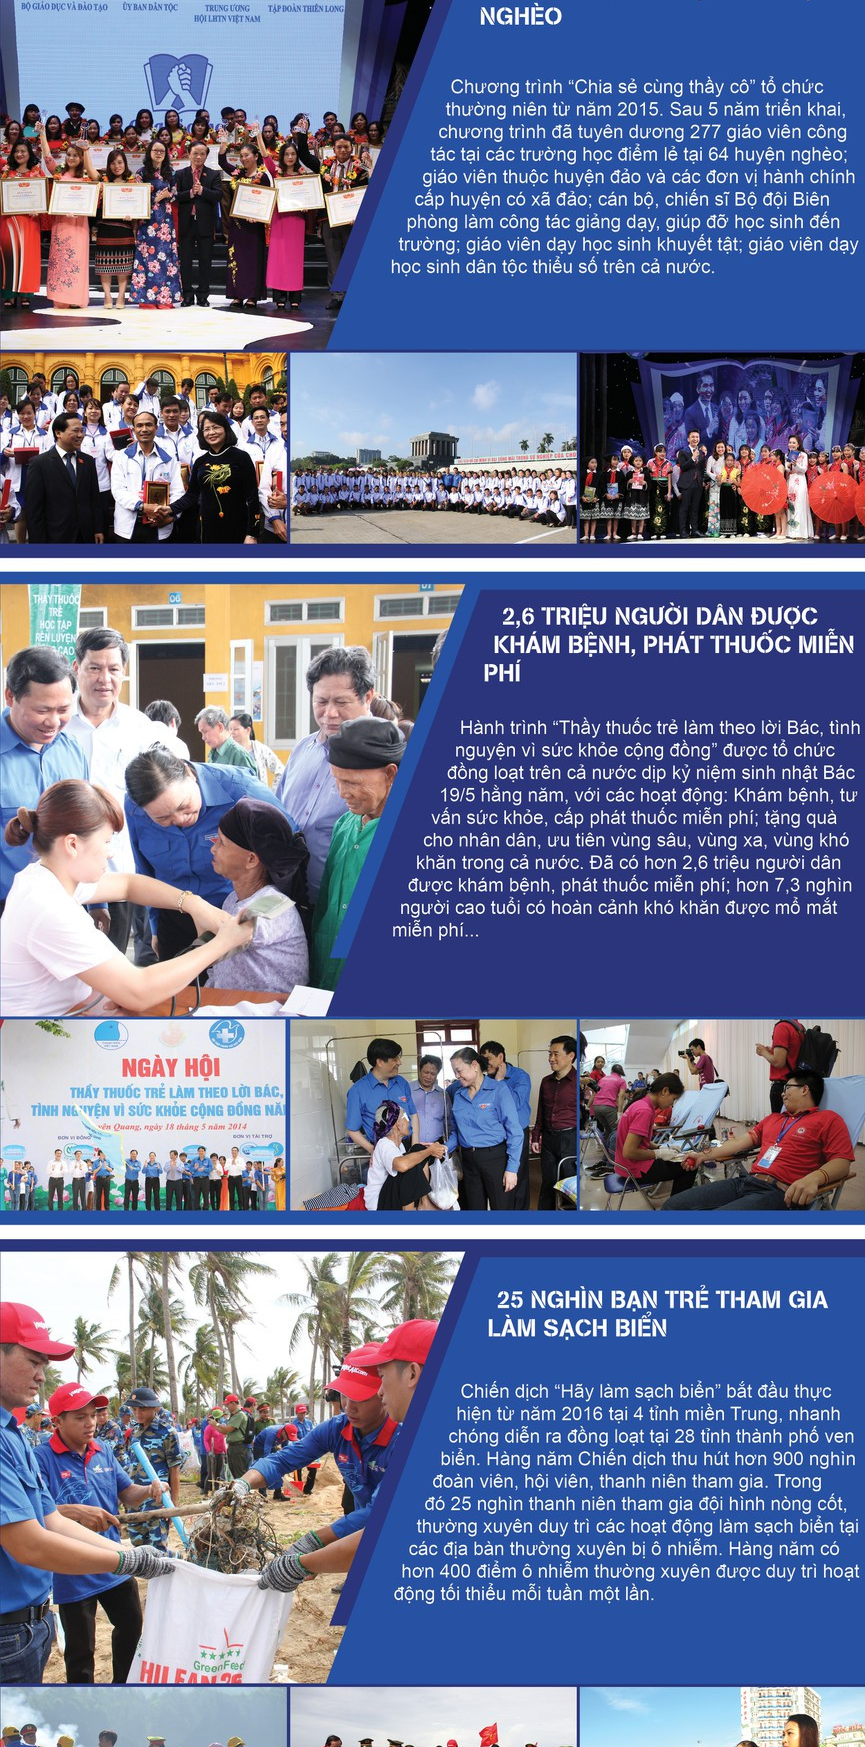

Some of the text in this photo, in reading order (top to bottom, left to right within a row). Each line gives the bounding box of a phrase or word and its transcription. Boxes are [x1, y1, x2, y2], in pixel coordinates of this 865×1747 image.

[21, 3, 108, 12] BỘ GIÁO DỤC VÀ ĐÀO TẠO
[49, 606, 62, 618] TRẺ
[40, 619, 72, 633] HỌC TẬP
[122, 1054, 220, 1081] NGÀY HỘI
[70, 1083, 284, 1101] THẦY THUỐC TRẺ LÀM THEO LỜI BÁC,
